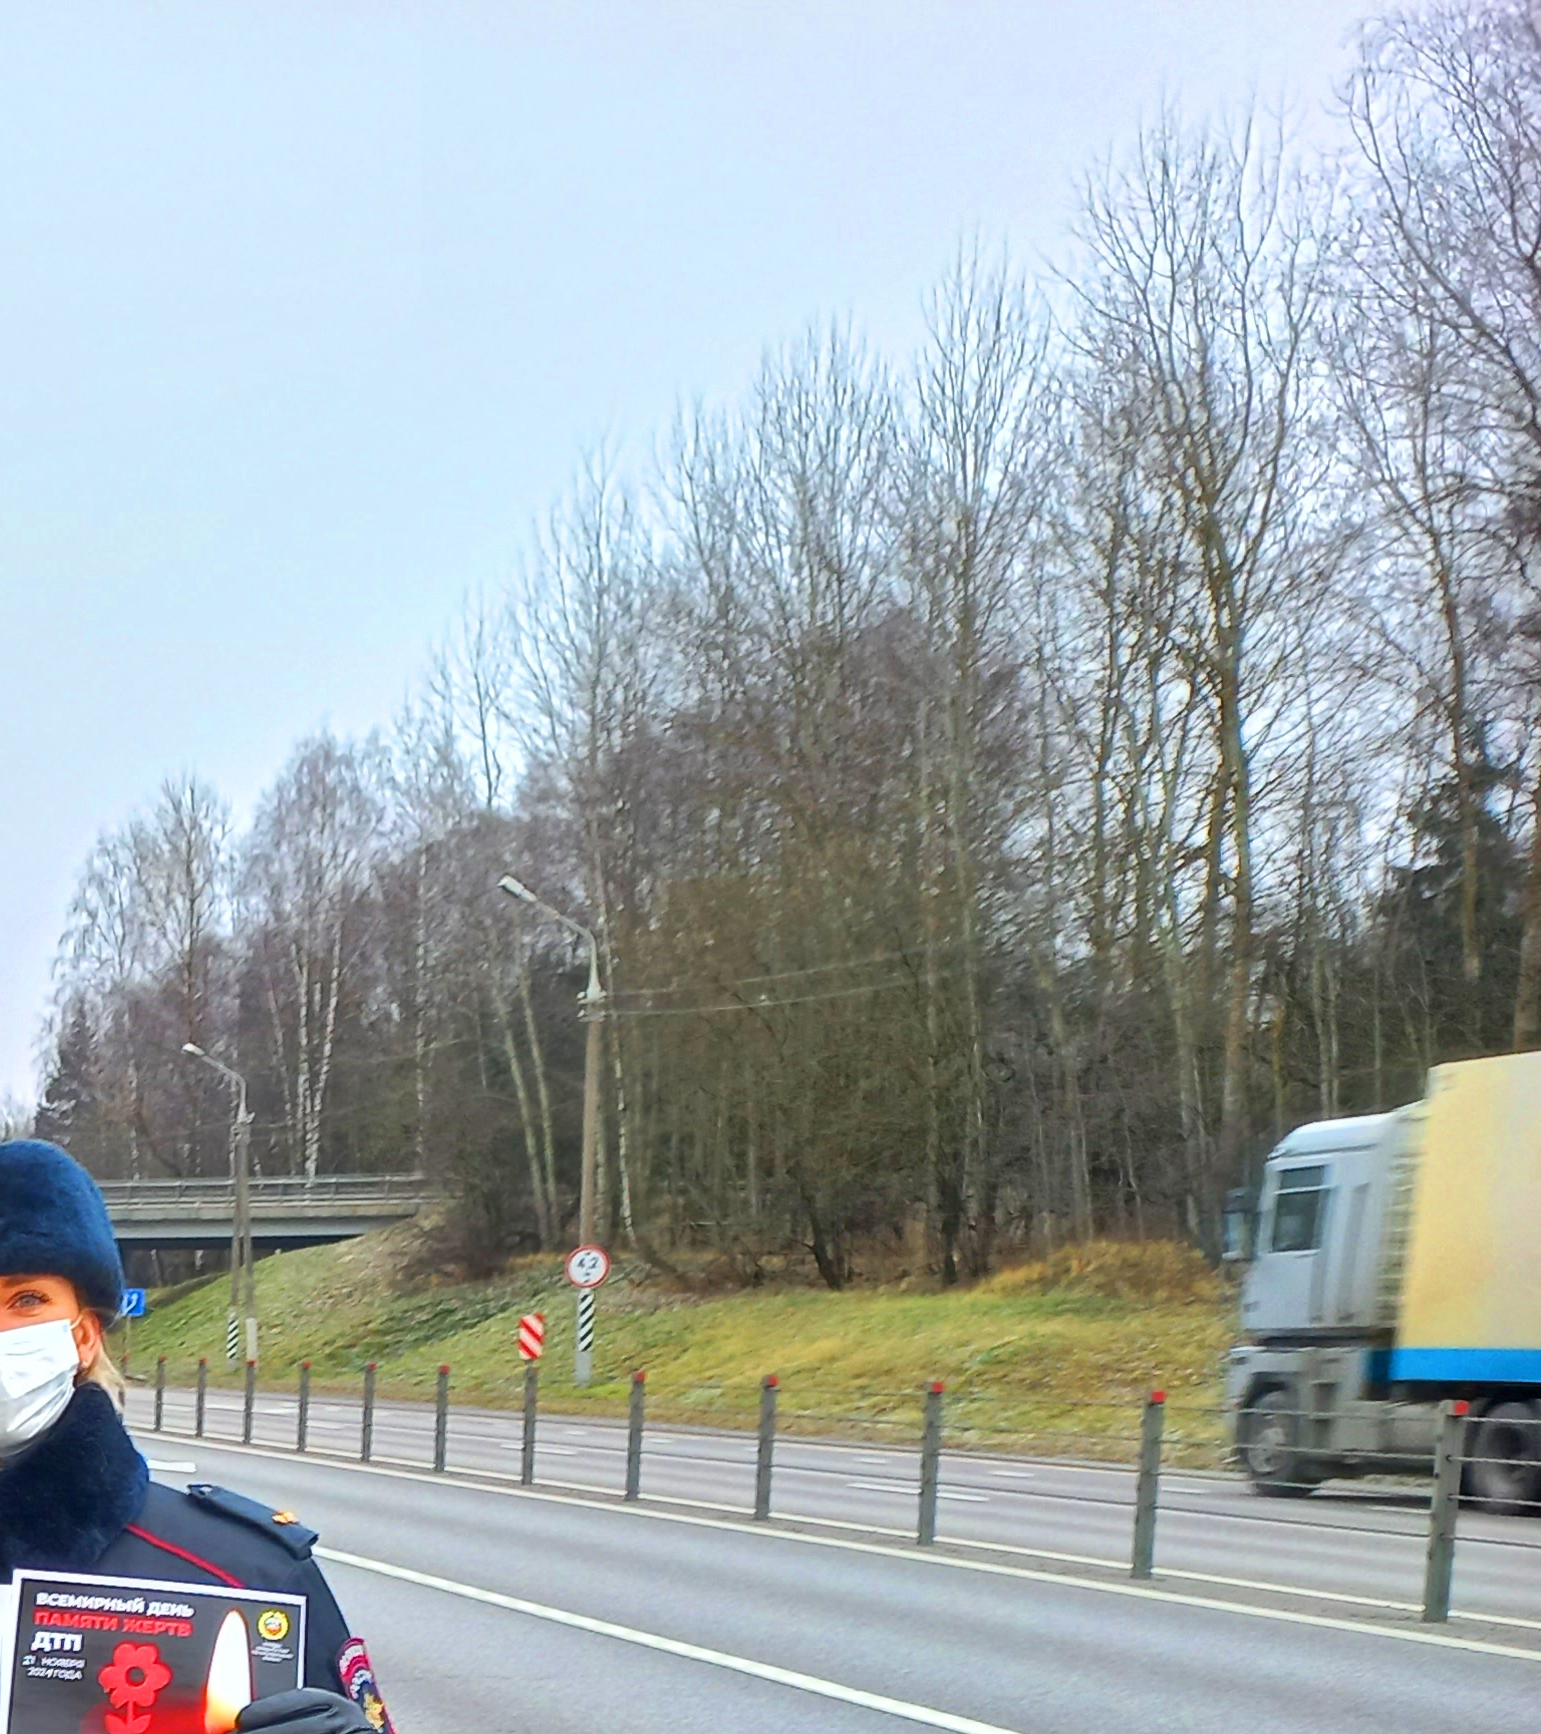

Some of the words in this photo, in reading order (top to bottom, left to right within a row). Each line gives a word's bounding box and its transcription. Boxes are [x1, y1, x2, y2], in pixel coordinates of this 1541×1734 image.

[35, 1592, 146, 1614] ВСЕМИРНЫЙ
[146, 1601, 195, 1618] ДЕНЬ
[34, 1611, 120, 1632] ПАМЯТИ
[121, 1618, 193, 1637] ЖЕРТВ
[30, 1631, 83, 1652] ДТП
